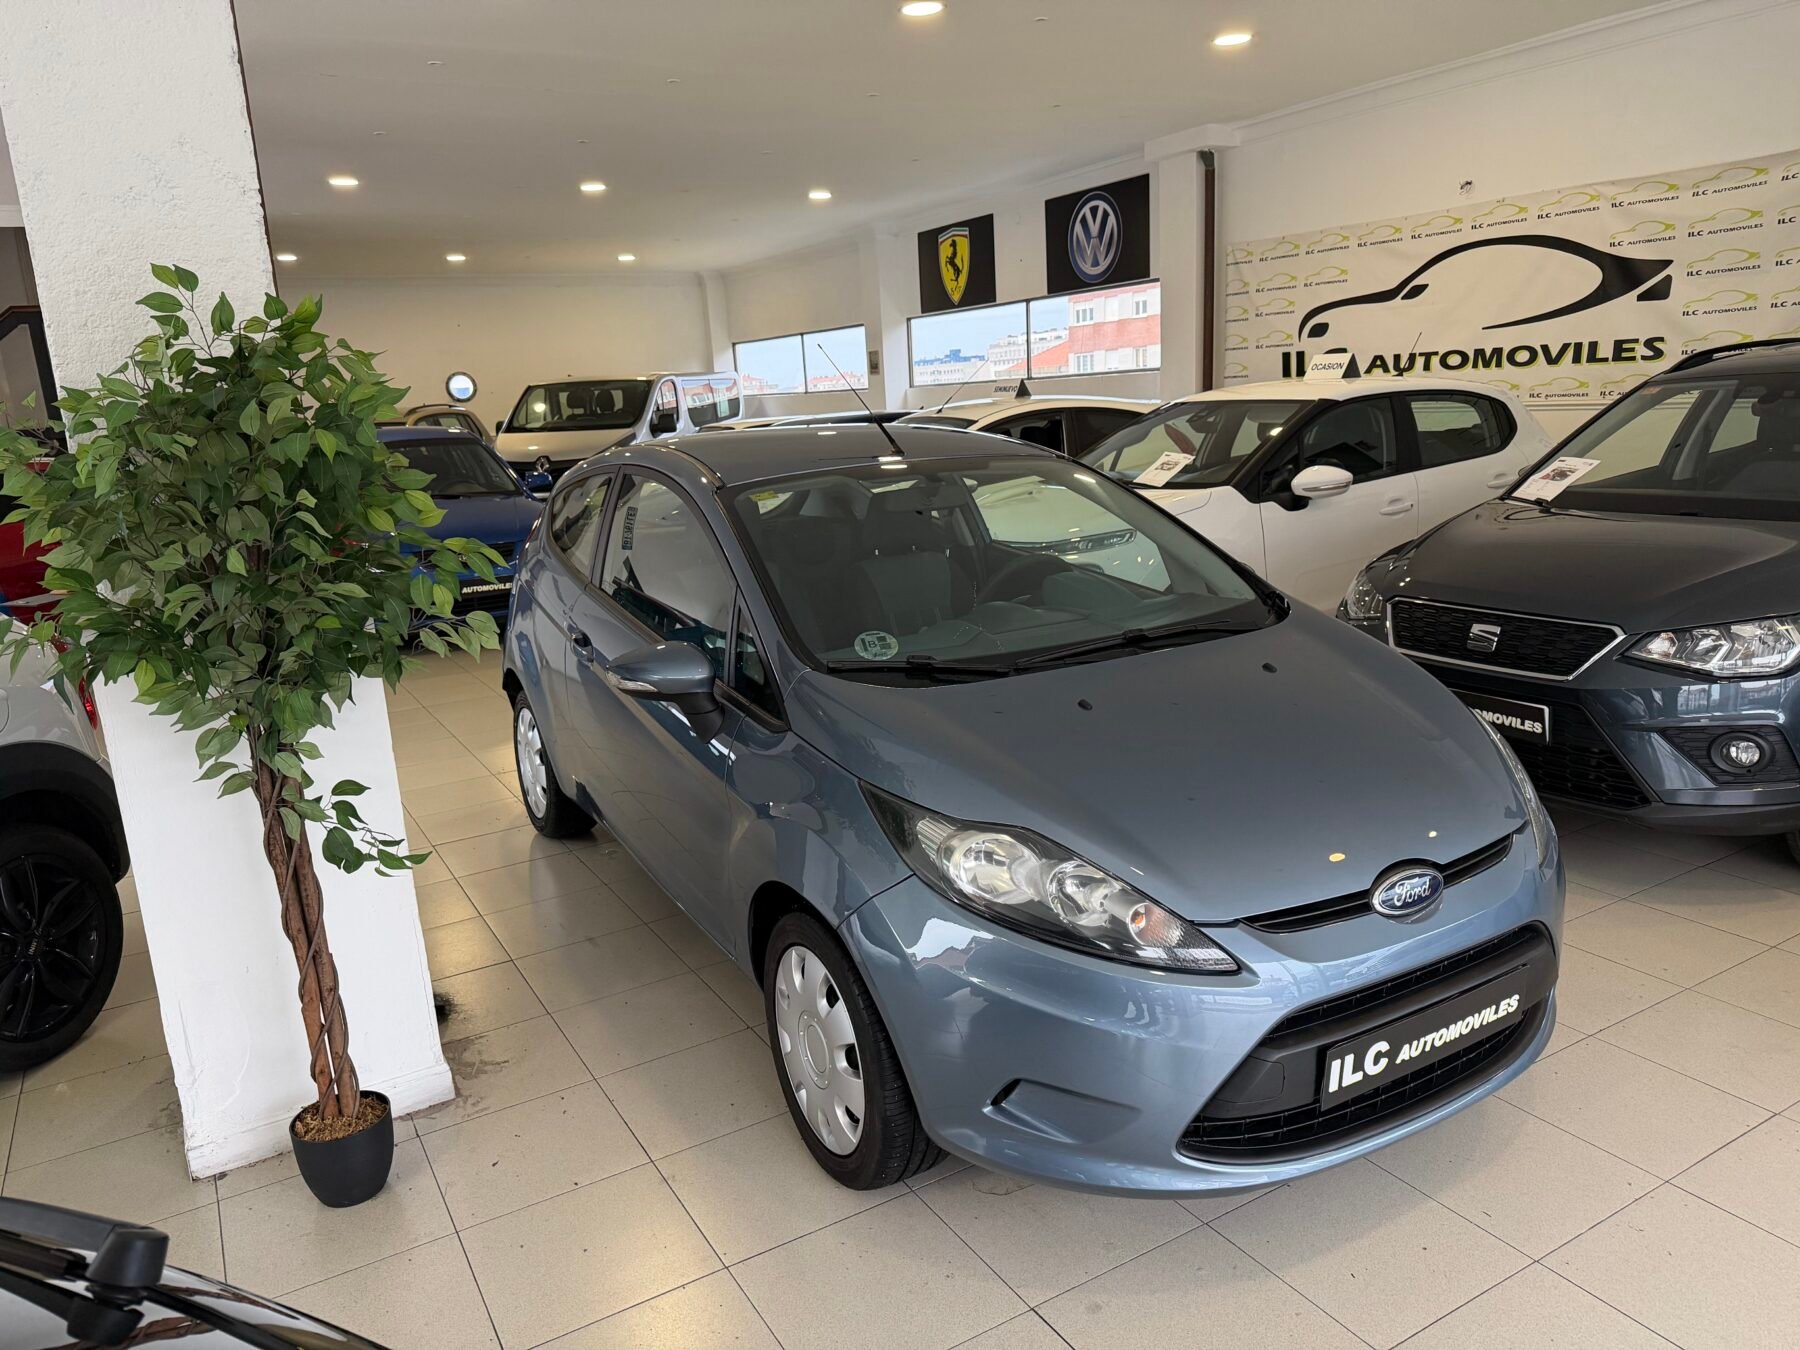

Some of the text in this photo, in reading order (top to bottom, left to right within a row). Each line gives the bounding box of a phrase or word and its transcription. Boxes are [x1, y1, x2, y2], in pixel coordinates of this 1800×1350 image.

[1692, 180, 1768, 197] ILC AUTOMOVILES
[1627, 195, 1680, 206] AUTOMOVILES
[1537, 206, 1600, 220] ILC AUTOMOVILES
[1486, 218, 1528, 227] AUTOMOVILES
[1777, 216, 1797, 225] ILC
[1424, 228, 1463, 238] AUTOMOVILES
[1688, 223, 1764, 238] ILC AUTOMOVILES
[1609, 235, 1677, 248] ILC AUTOMOVILES
[1775, 258, 1793, 267] ILC
[1705, 264, 1761, 275] AUTOMOVILES
[1702, 305, 1757, 315] AUTOMOVILES
[1282, 337, 1665, 378] IL AUTOMOVILES
[1311, 362, 1345, 371] OCASION
[1394, 876, 1432, 906] Ford
[1328, 994, 1520, 1093] ILC AUTOMOVILES
